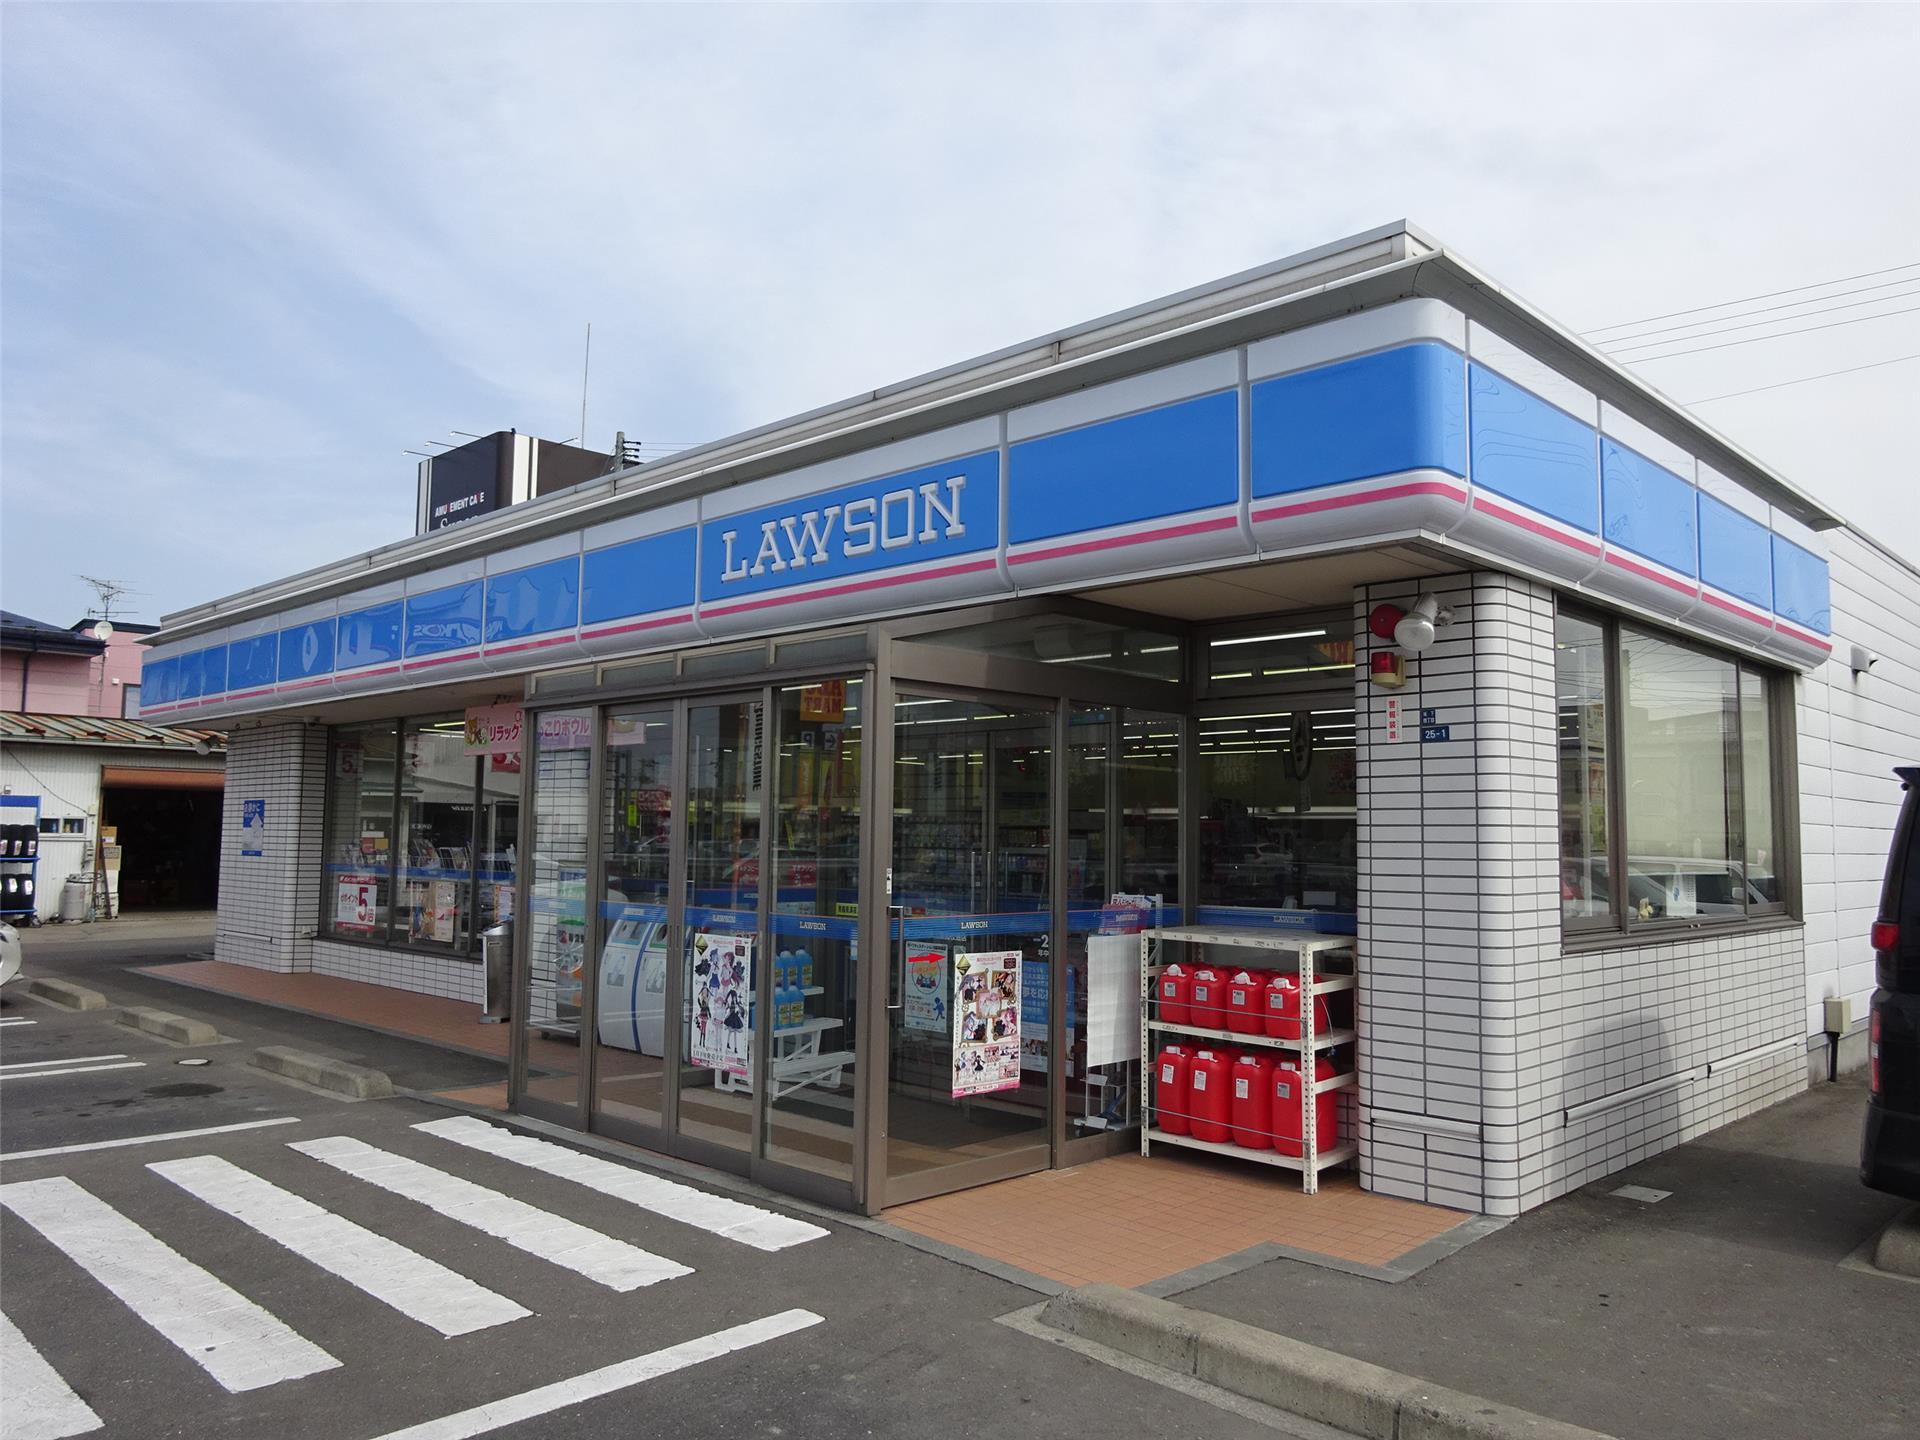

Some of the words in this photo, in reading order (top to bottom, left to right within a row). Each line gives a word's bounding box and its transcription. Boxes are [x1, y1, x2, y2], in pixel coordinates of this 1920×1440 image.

[720, 474, 967, 584] LAWSON
[489, 723, 522, 743] リラック
[1425, 729, 1446, 739] 25-1
[358, 887, 368, 921] 5
[961, 920, 988, 929] LAWSON
